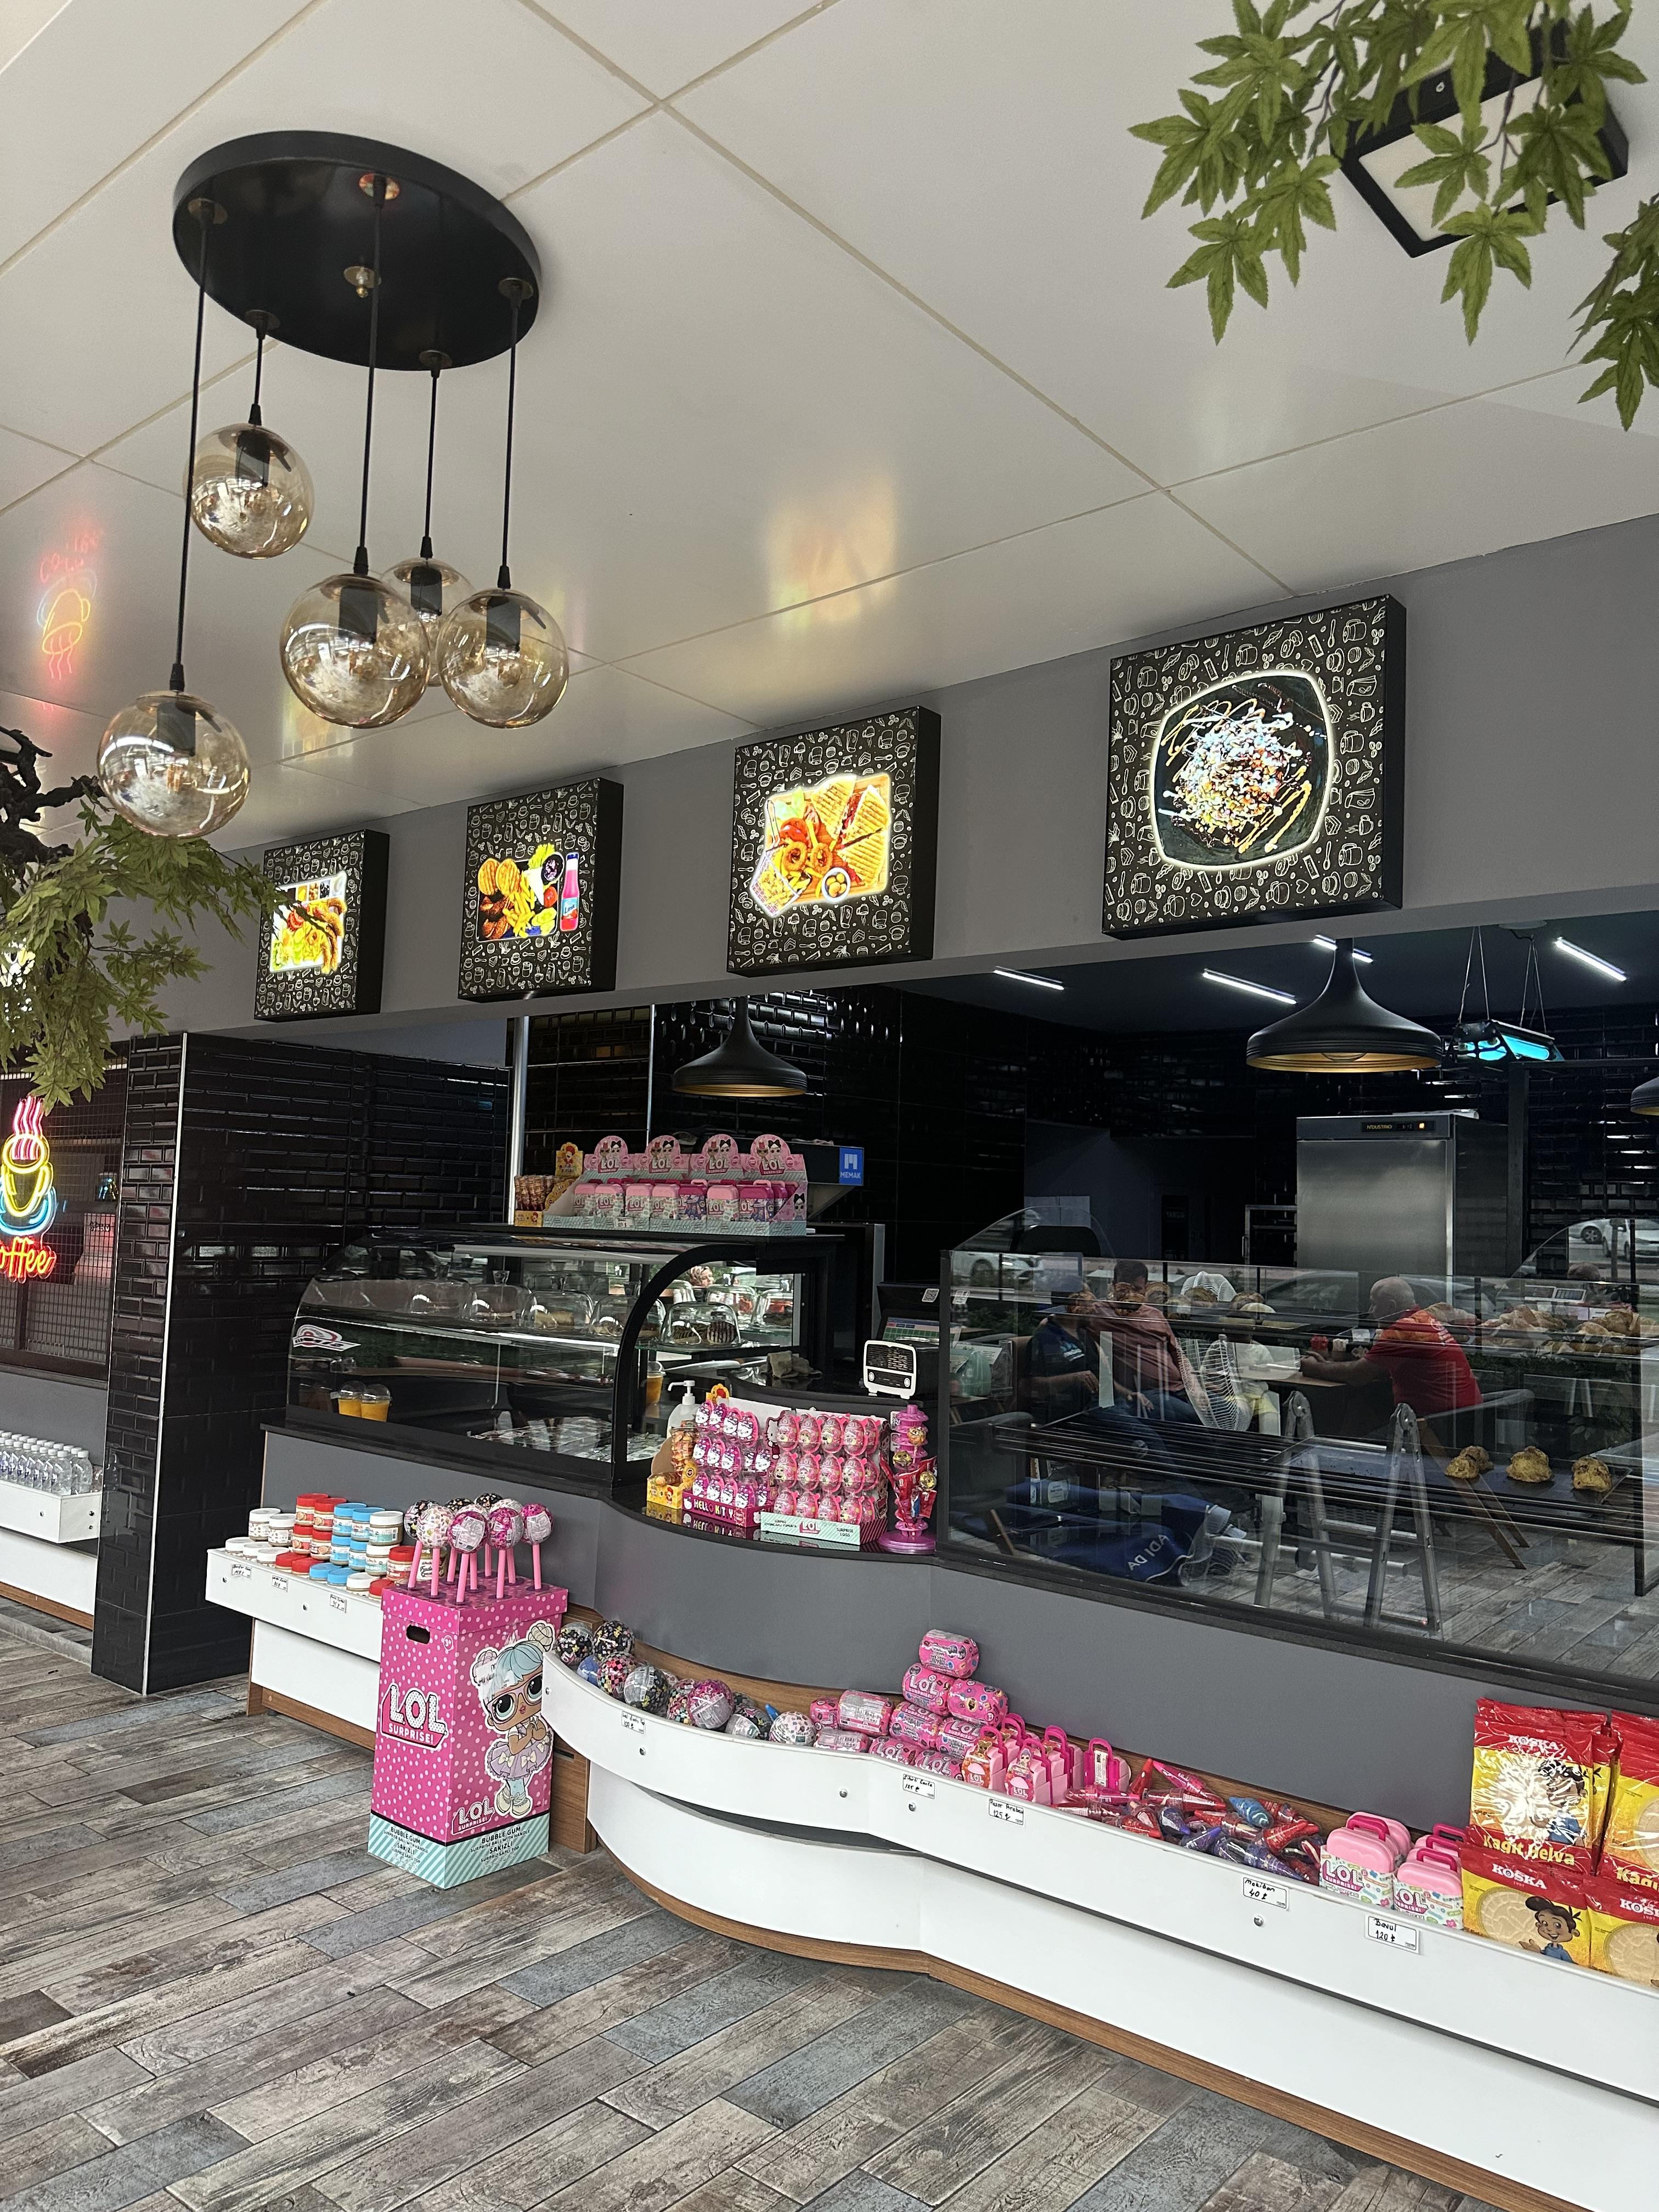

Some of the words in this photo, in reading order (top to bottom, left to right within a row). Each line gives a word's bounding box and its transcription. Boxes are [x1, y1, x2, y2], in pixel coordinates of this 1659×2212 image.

[693, 1498, 714, 1513] HELLO
[388, 1723, 433, 1745] SURPRISE!
[994, 1810, 1003, 1819] 125
[391, 1826, 409, 1839] BUBBLE
[409, 1835, 421, 1844] GUM
[481, 1832, 505, 1844] BUBBLE
[507, 1826, 521, 1836] GUM
[397, 1842, 415, 1855] SAKIZLI
[489, 1841, 513, 1854] SAKIZLI
[1492, 1863, 1548, 1889] KOSKA
[1249, 1888, 1260, 1897] 40
[1375, 1930, 1389, 1941] 120
